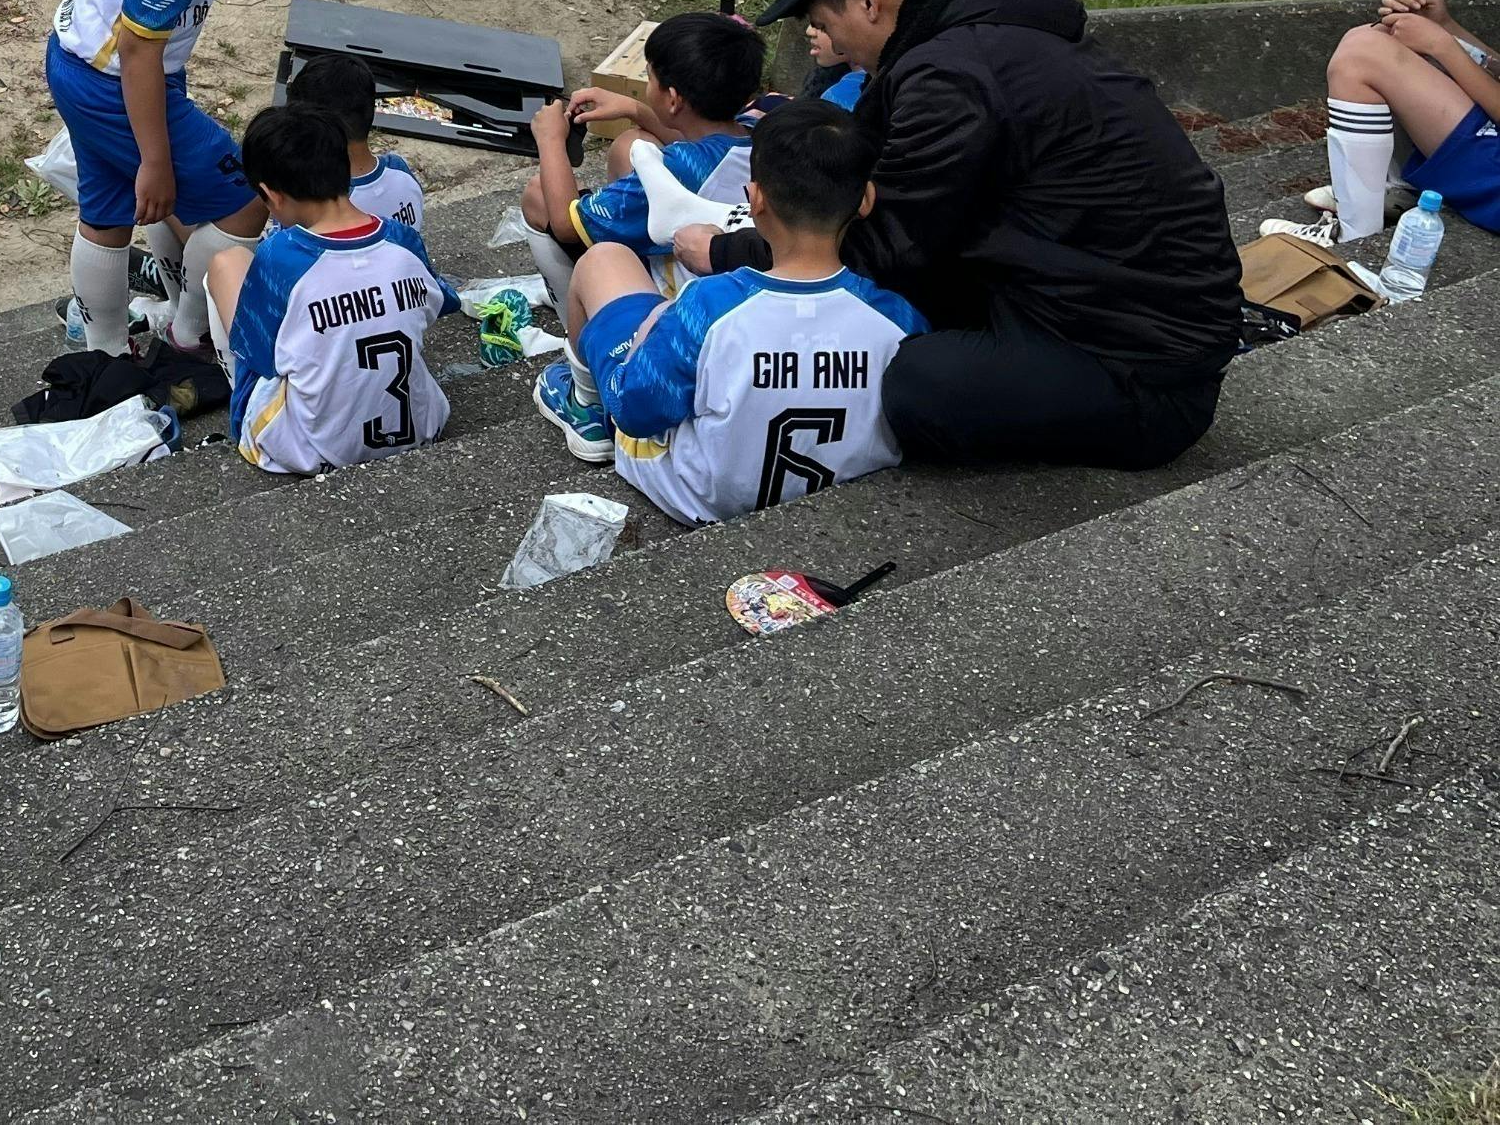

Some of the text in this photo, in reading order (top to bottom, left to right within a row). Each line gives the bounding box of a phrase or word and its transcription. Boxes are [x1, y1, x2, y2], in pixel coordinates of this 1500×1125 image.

[308, 278, 428, 334] QUANG VINH
[355, 330, 416, 449] 3
[753, 351, 868, 389] GIA ANH
[754, 408, 847, 511] 6
